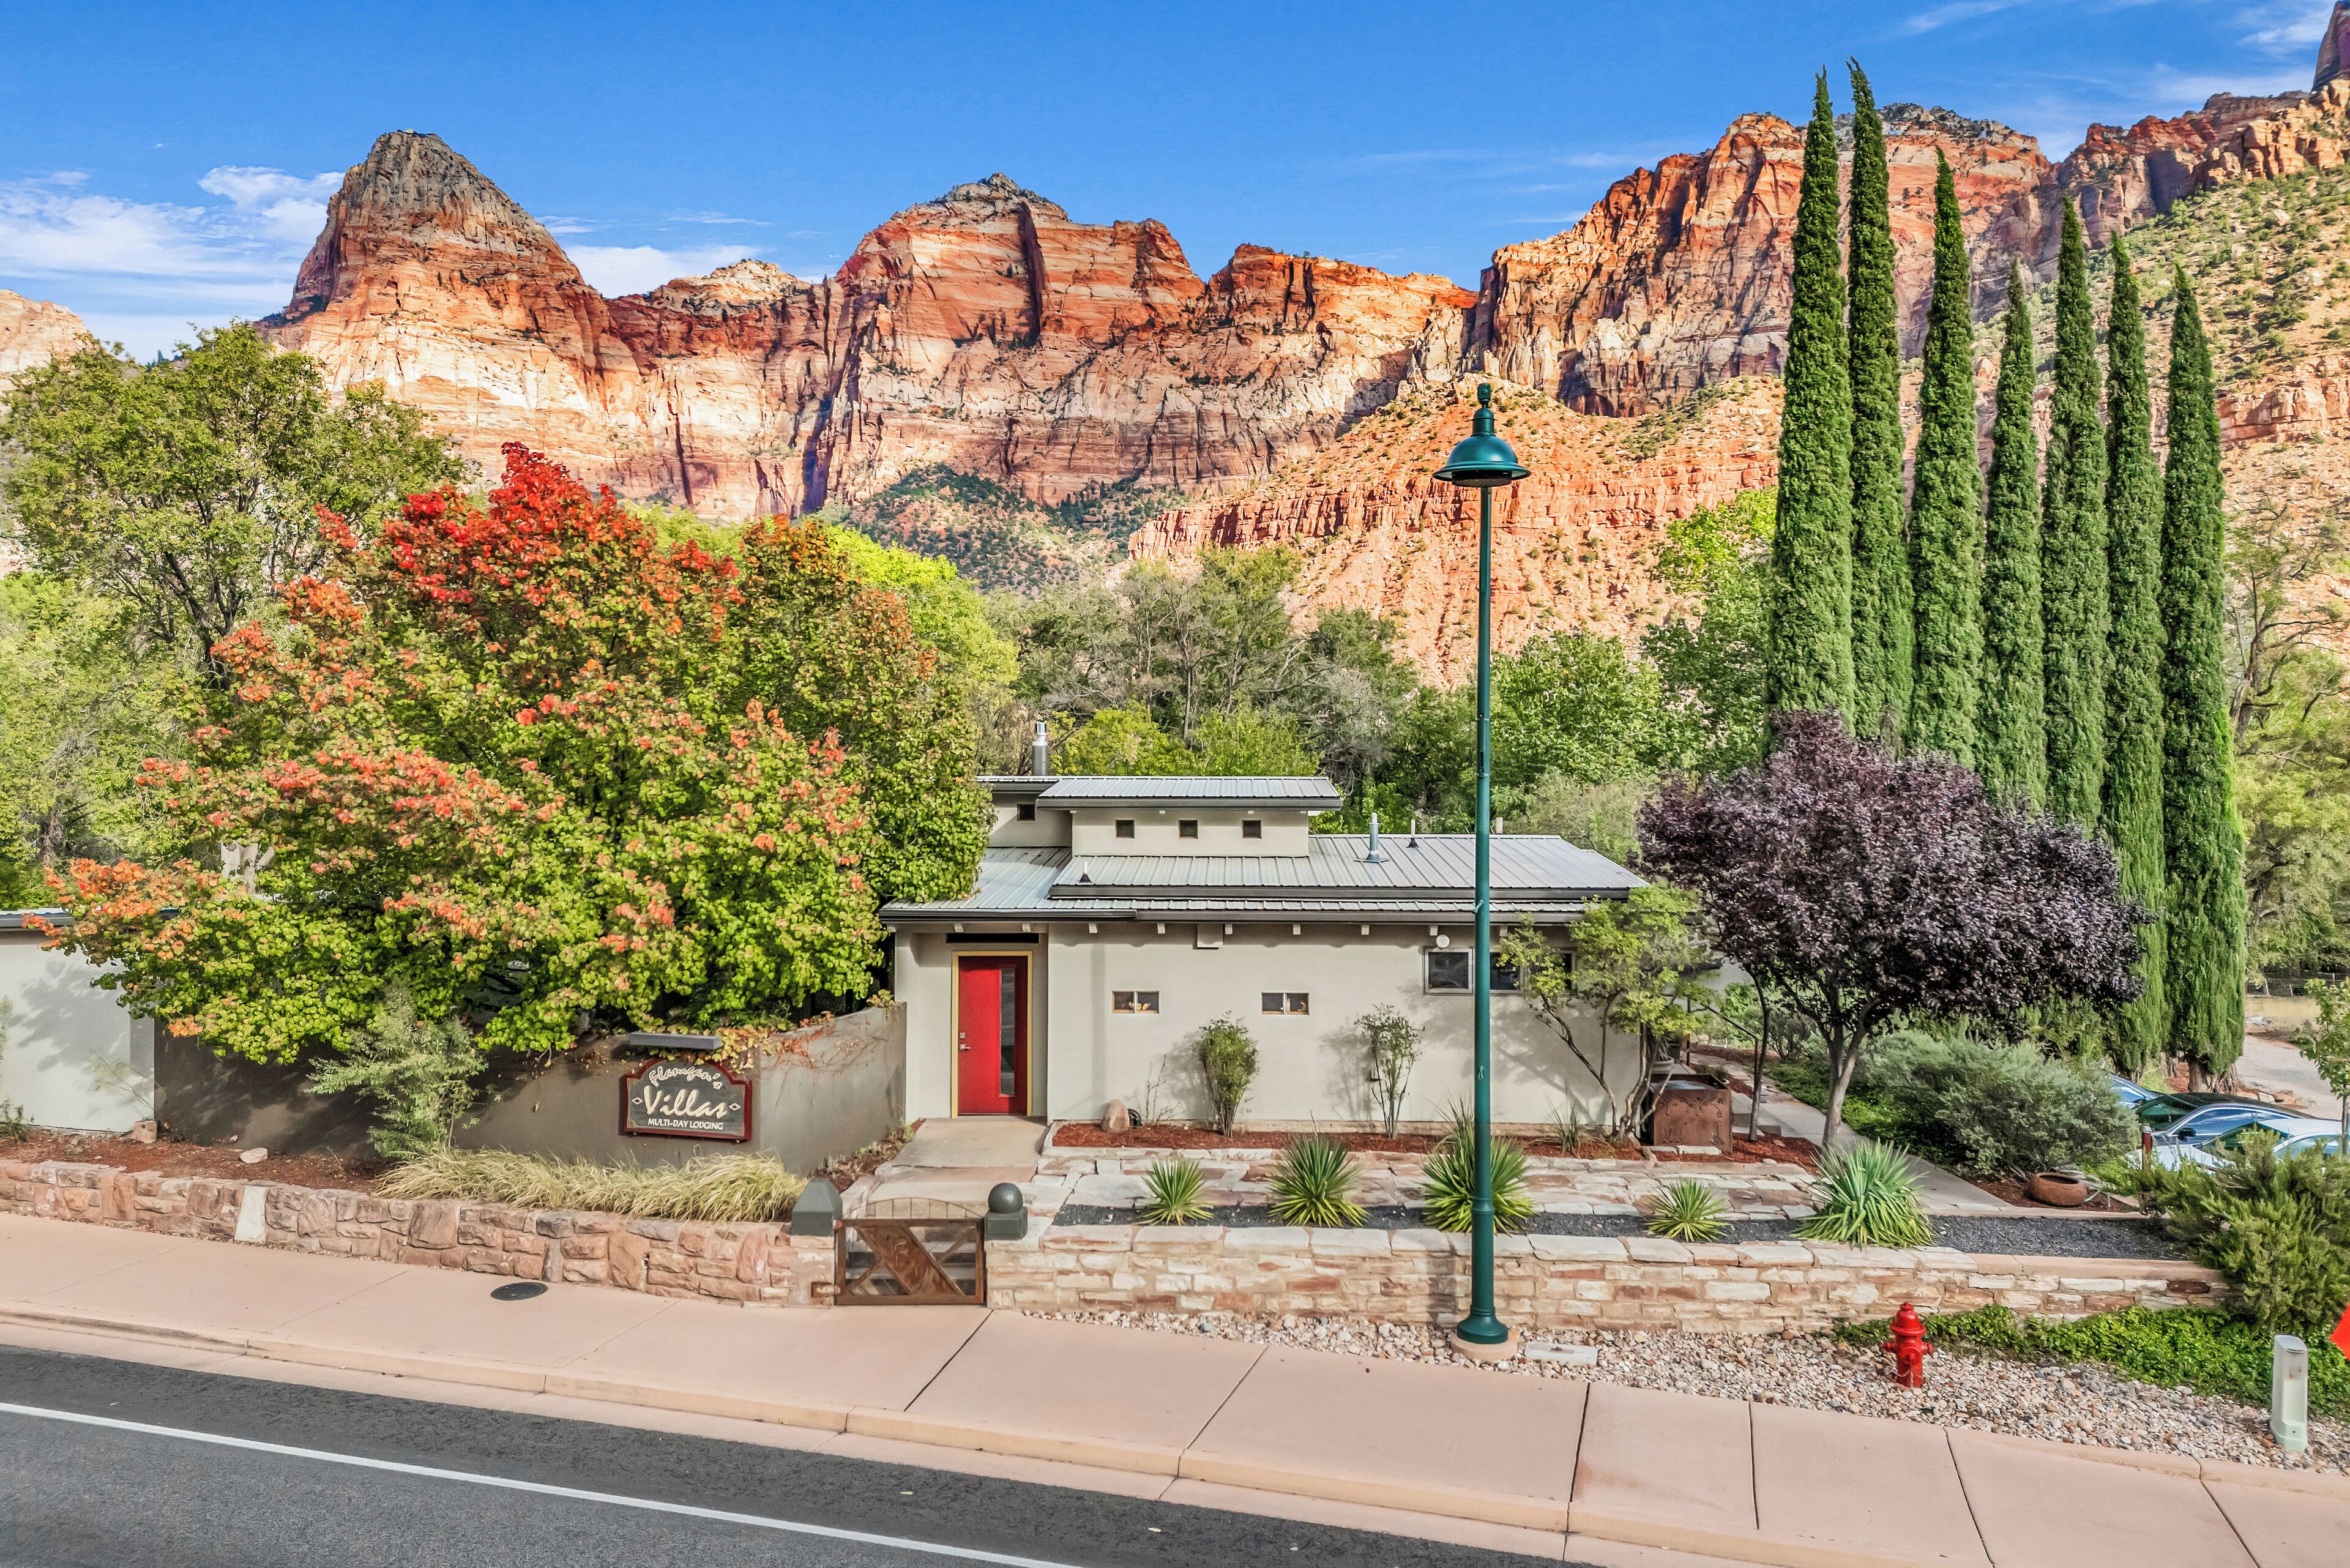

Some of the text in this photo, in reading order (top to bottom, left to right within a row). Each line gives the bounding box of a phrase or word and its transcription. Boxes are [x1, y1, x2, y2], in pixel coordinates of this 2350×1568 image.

[644, 1085, 727, 1119] Villas
[648, 1118, 723, 1130] MULTI-DAY LODGING
